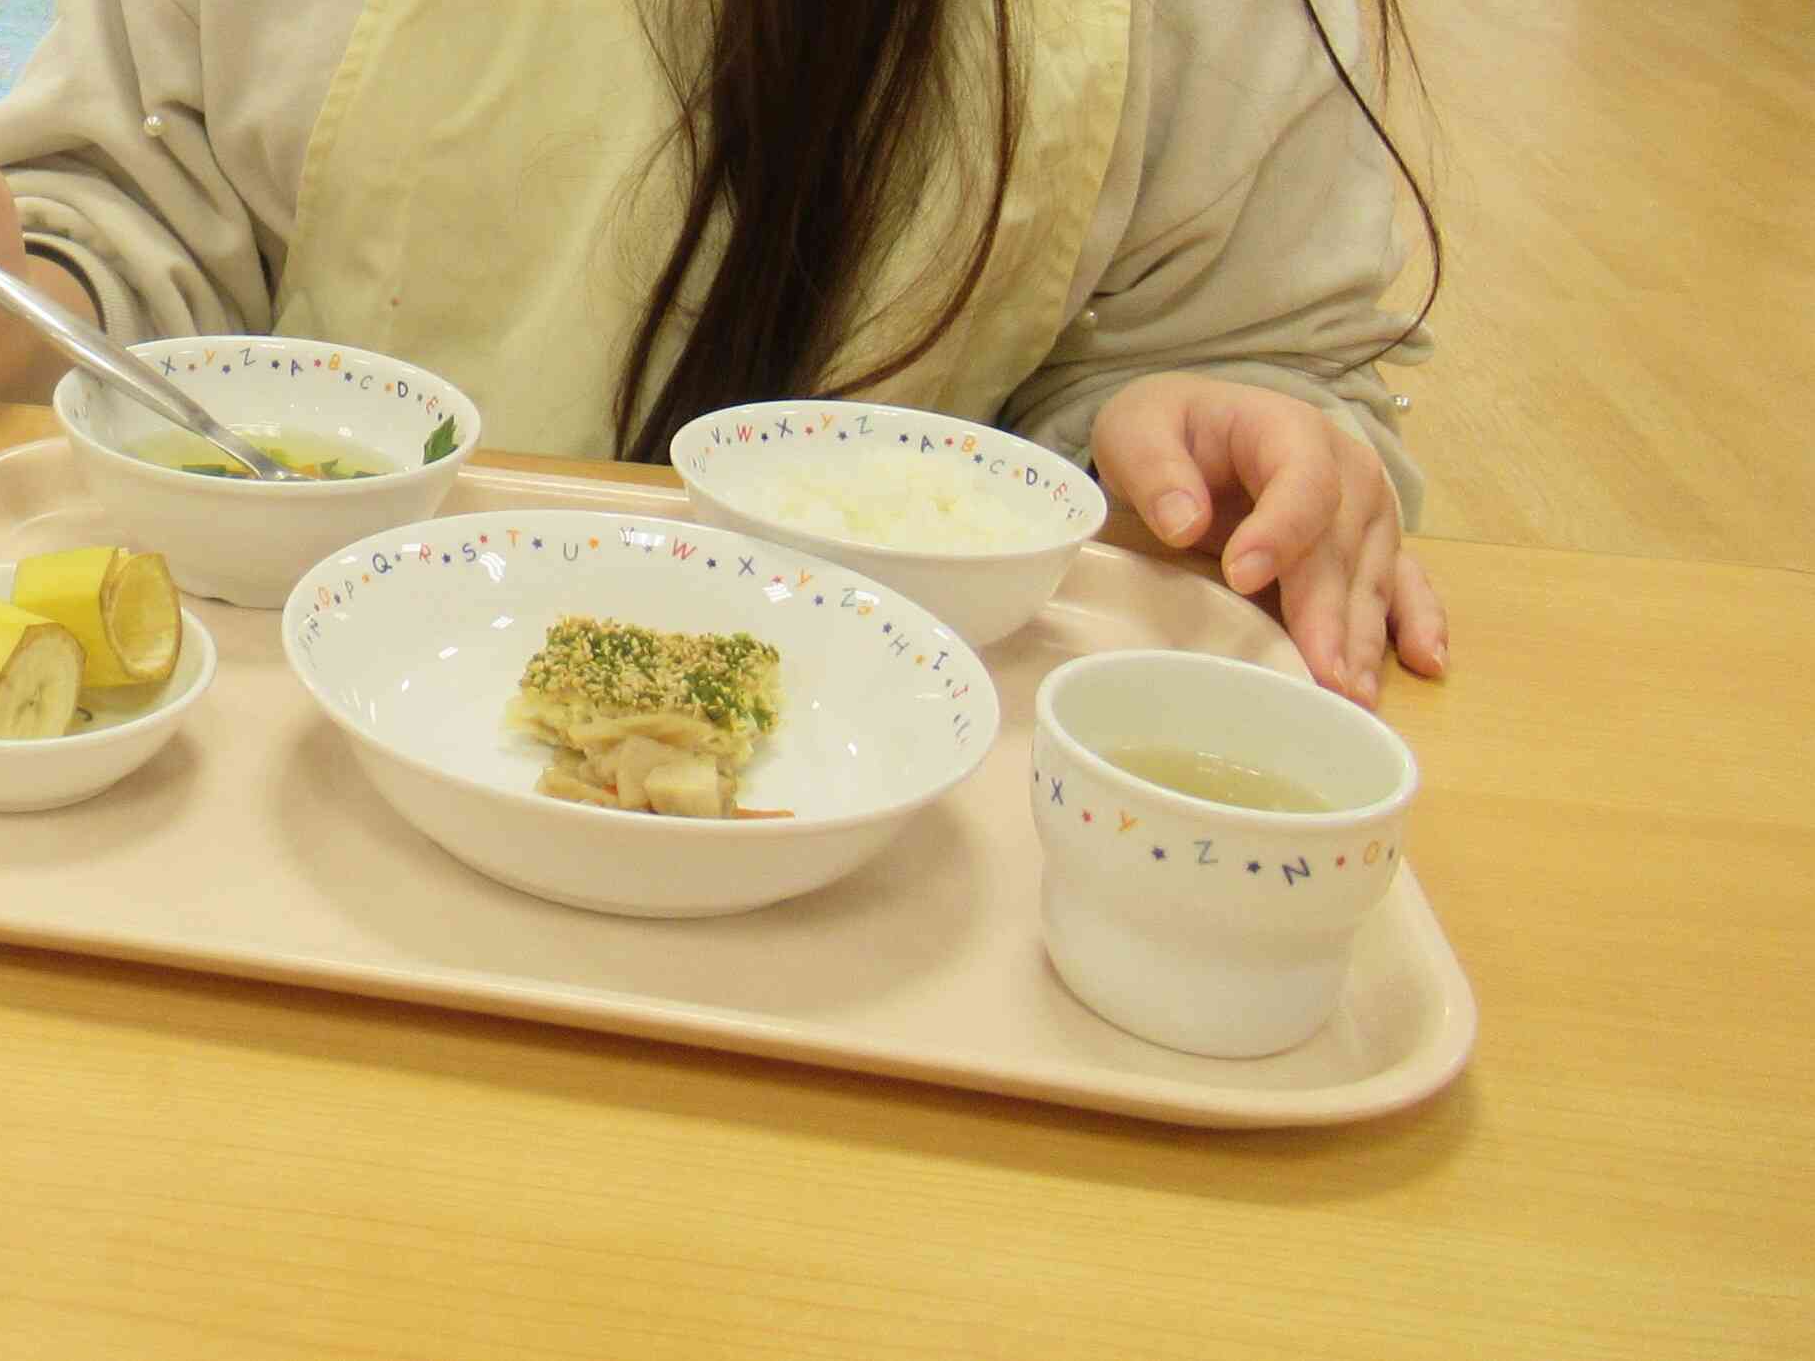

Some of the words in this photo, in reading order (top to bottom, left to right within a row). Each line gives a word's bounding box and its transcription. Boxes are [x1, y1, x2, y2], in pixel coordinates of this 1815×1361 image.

[160, 355, 178, 376] X
[204, 348, 216, 365] Y
[239, 347, 256, 367] Z
[290, 359, 303, 377] A
[360, 375, 373, 390] C
[398, 381, 409, 398] D
[736, 423, 753, 443] W
[775, 417, 794, 439] X
[821, 414, 834, 431] Y
[856, 415, 874, 435] Z
[920, 435, 934, 453] A
[961, 435, 976, 453] B
[989, 459, 1005, 475] C
[1026, 467, 1038, 485] D
[1050, 482, 1068, 501] E
[344, 581, 354, 599] P
[372, 553, 393, 575] Q
[418, 544, 432, 565] R
[462, 543, 477, 563] S
[506, 529, 522, 548] T
[563, 542, 579, 561] U
[672, 535, 698, 561] W
[738, 556, 756, 576] X
[796, 567, 814, 589] Y
[841, 587, 858, 607] Z
[890, 633, 910, 655] H
[932, 651, 949, 671] I
[1051, 778, 1064, 807] X
[1118, 809, 1139, 833] Y
[1194, 841, 1218, 866] Z
[1281, 856, 1312, 887] N
[1363, 841, 1380, 866] O
